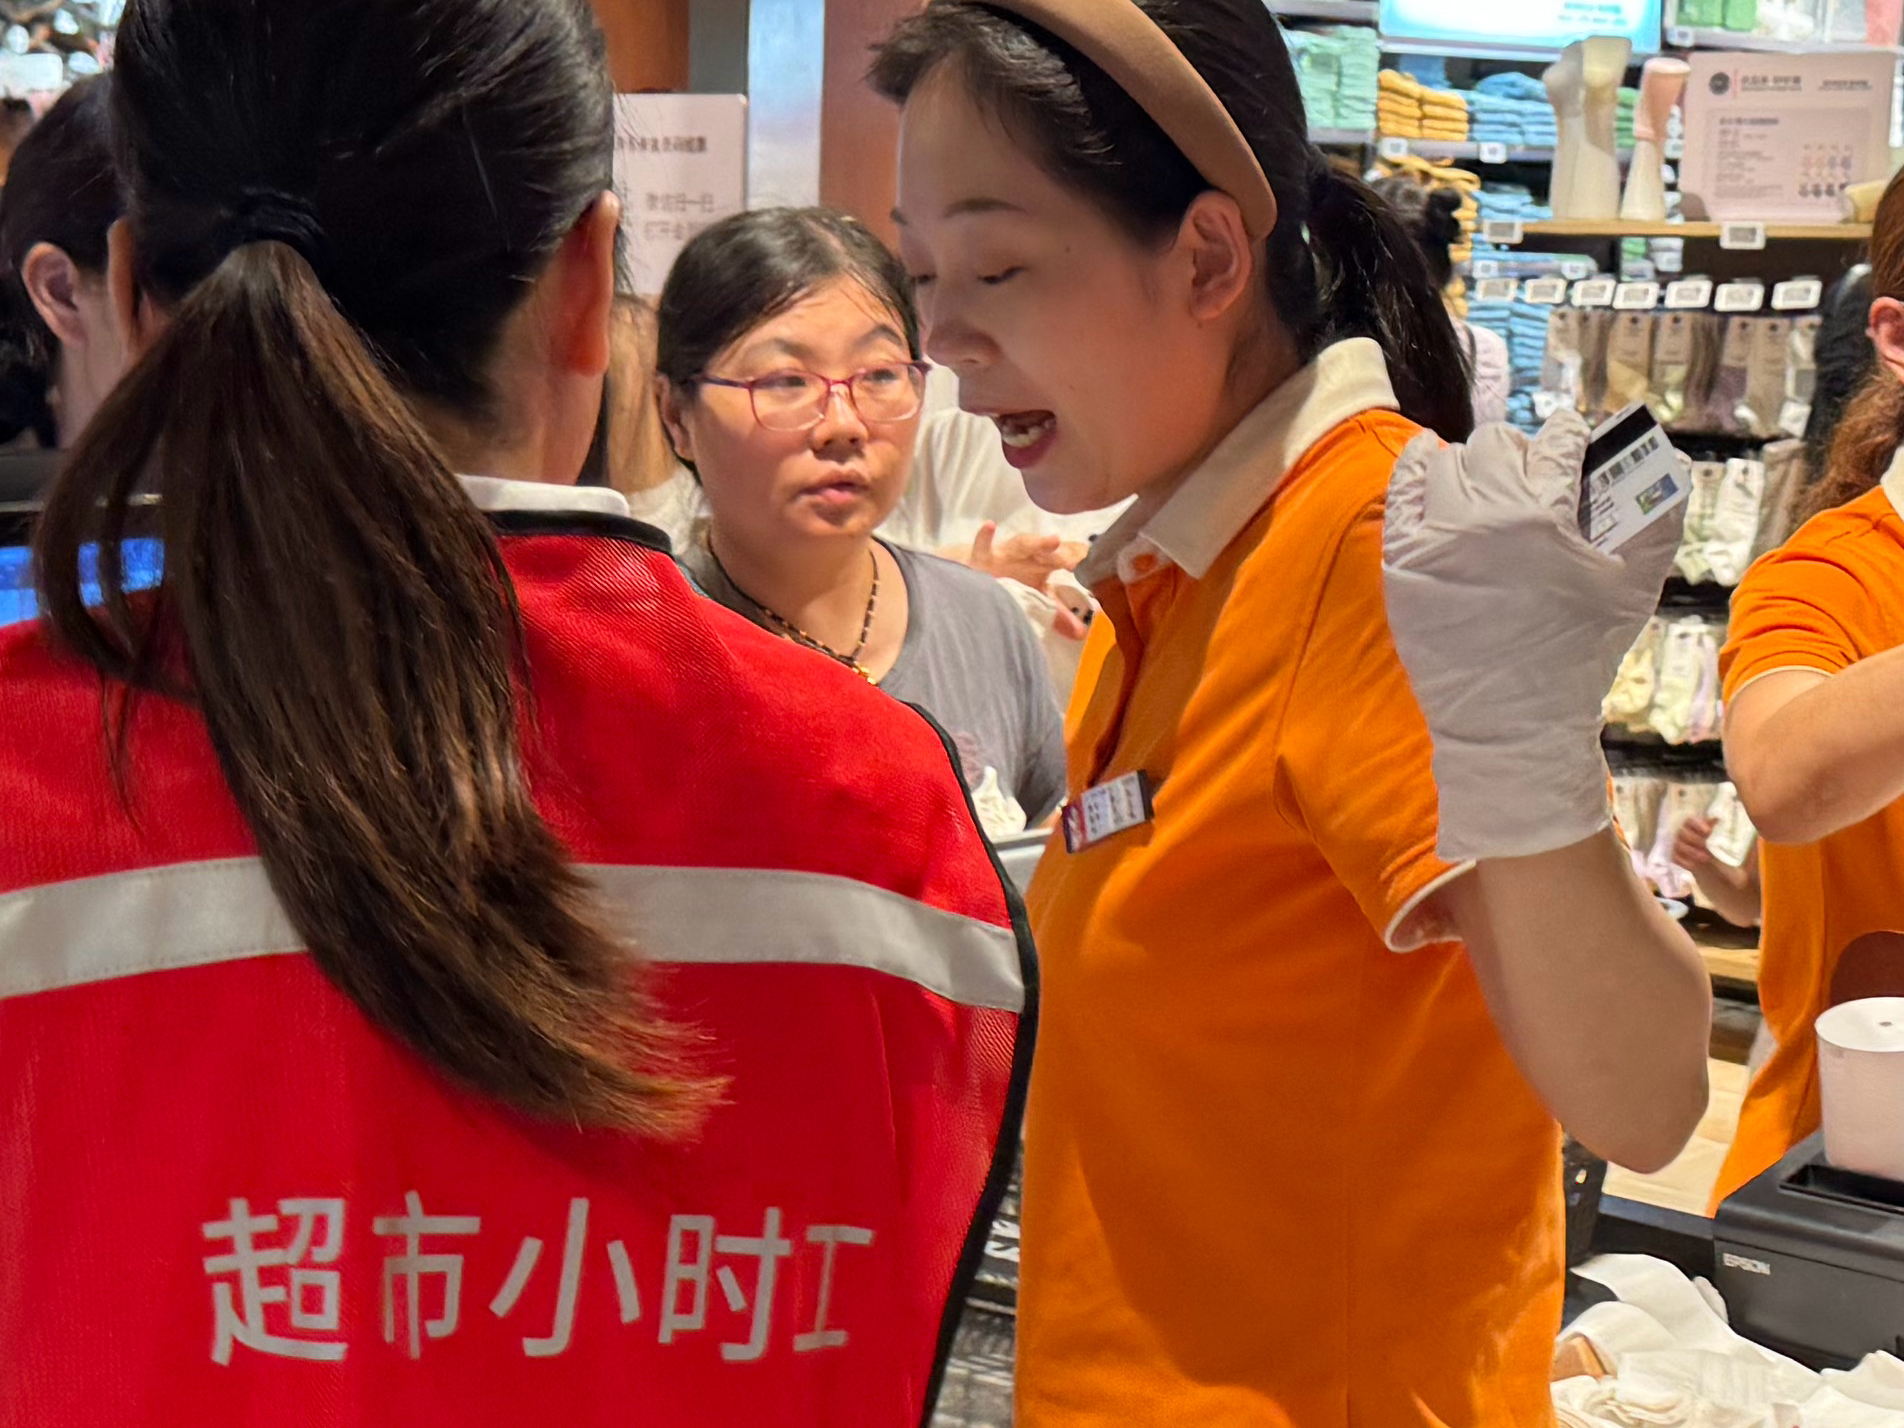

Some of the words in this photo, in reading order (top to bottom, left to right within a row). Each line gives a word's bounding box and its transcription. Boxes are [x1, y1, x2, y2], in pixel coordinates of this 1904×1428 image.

[202, 1190, 874, 1367] 超市小时工
